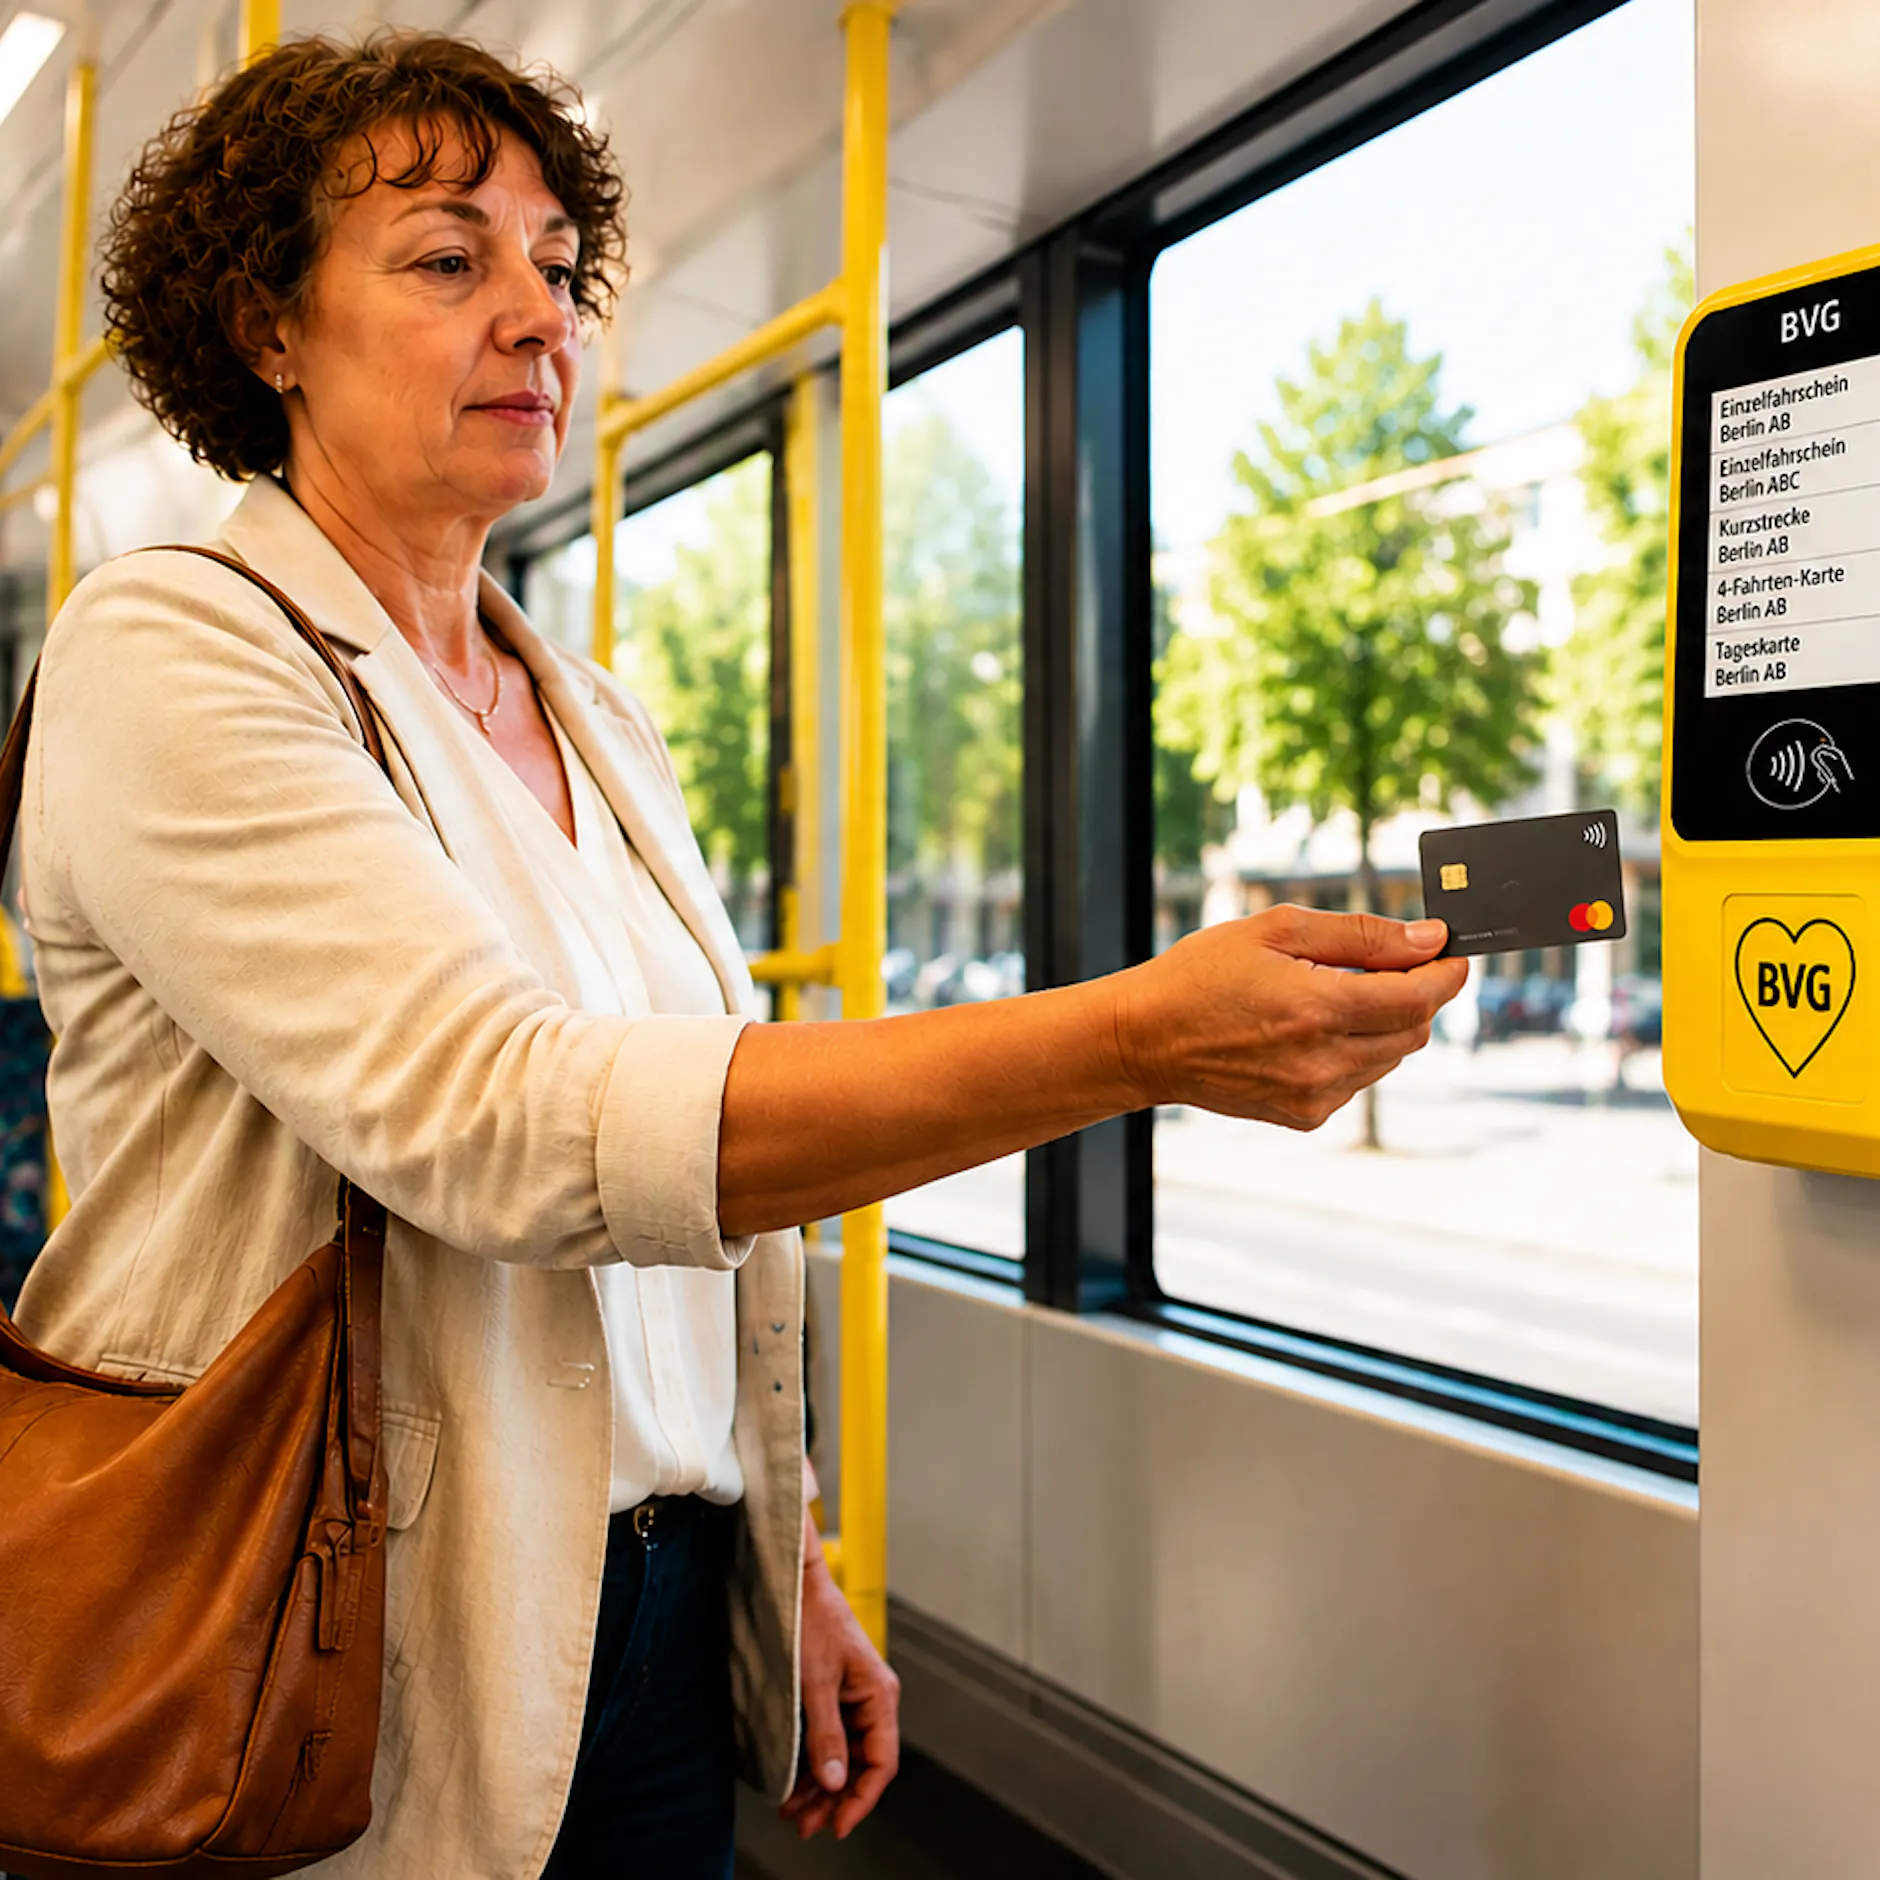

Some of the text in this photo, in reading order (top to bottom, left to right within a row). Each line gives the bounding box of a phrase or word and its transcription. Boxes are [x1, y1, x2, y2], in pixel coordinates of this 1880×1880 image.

[1781, 299, 1841, 343] BVG
[1720, 375, 1848, 419] Einzelfahrschein
[1720, 412, 1790, 443] Berlin AB
[1719, 437, 1846, 477] Einzelfahrschein
[1719, 472, 1800, 503] Berlin ABC
[1719, 507, 1810, 537] Kurzstrecke
[1719, 535, 1789, 563] Berlin AB
[1717, 566, 1845, 597] 4-Fahrten-Karte
[1717, 597, 1787, 624] Berlin AB
[1716, 636, 1800, 663] Tageskarte
[1715, 661, 1786, 686] Berlin AB
[1758, 961, 1830, 1012] BVG
